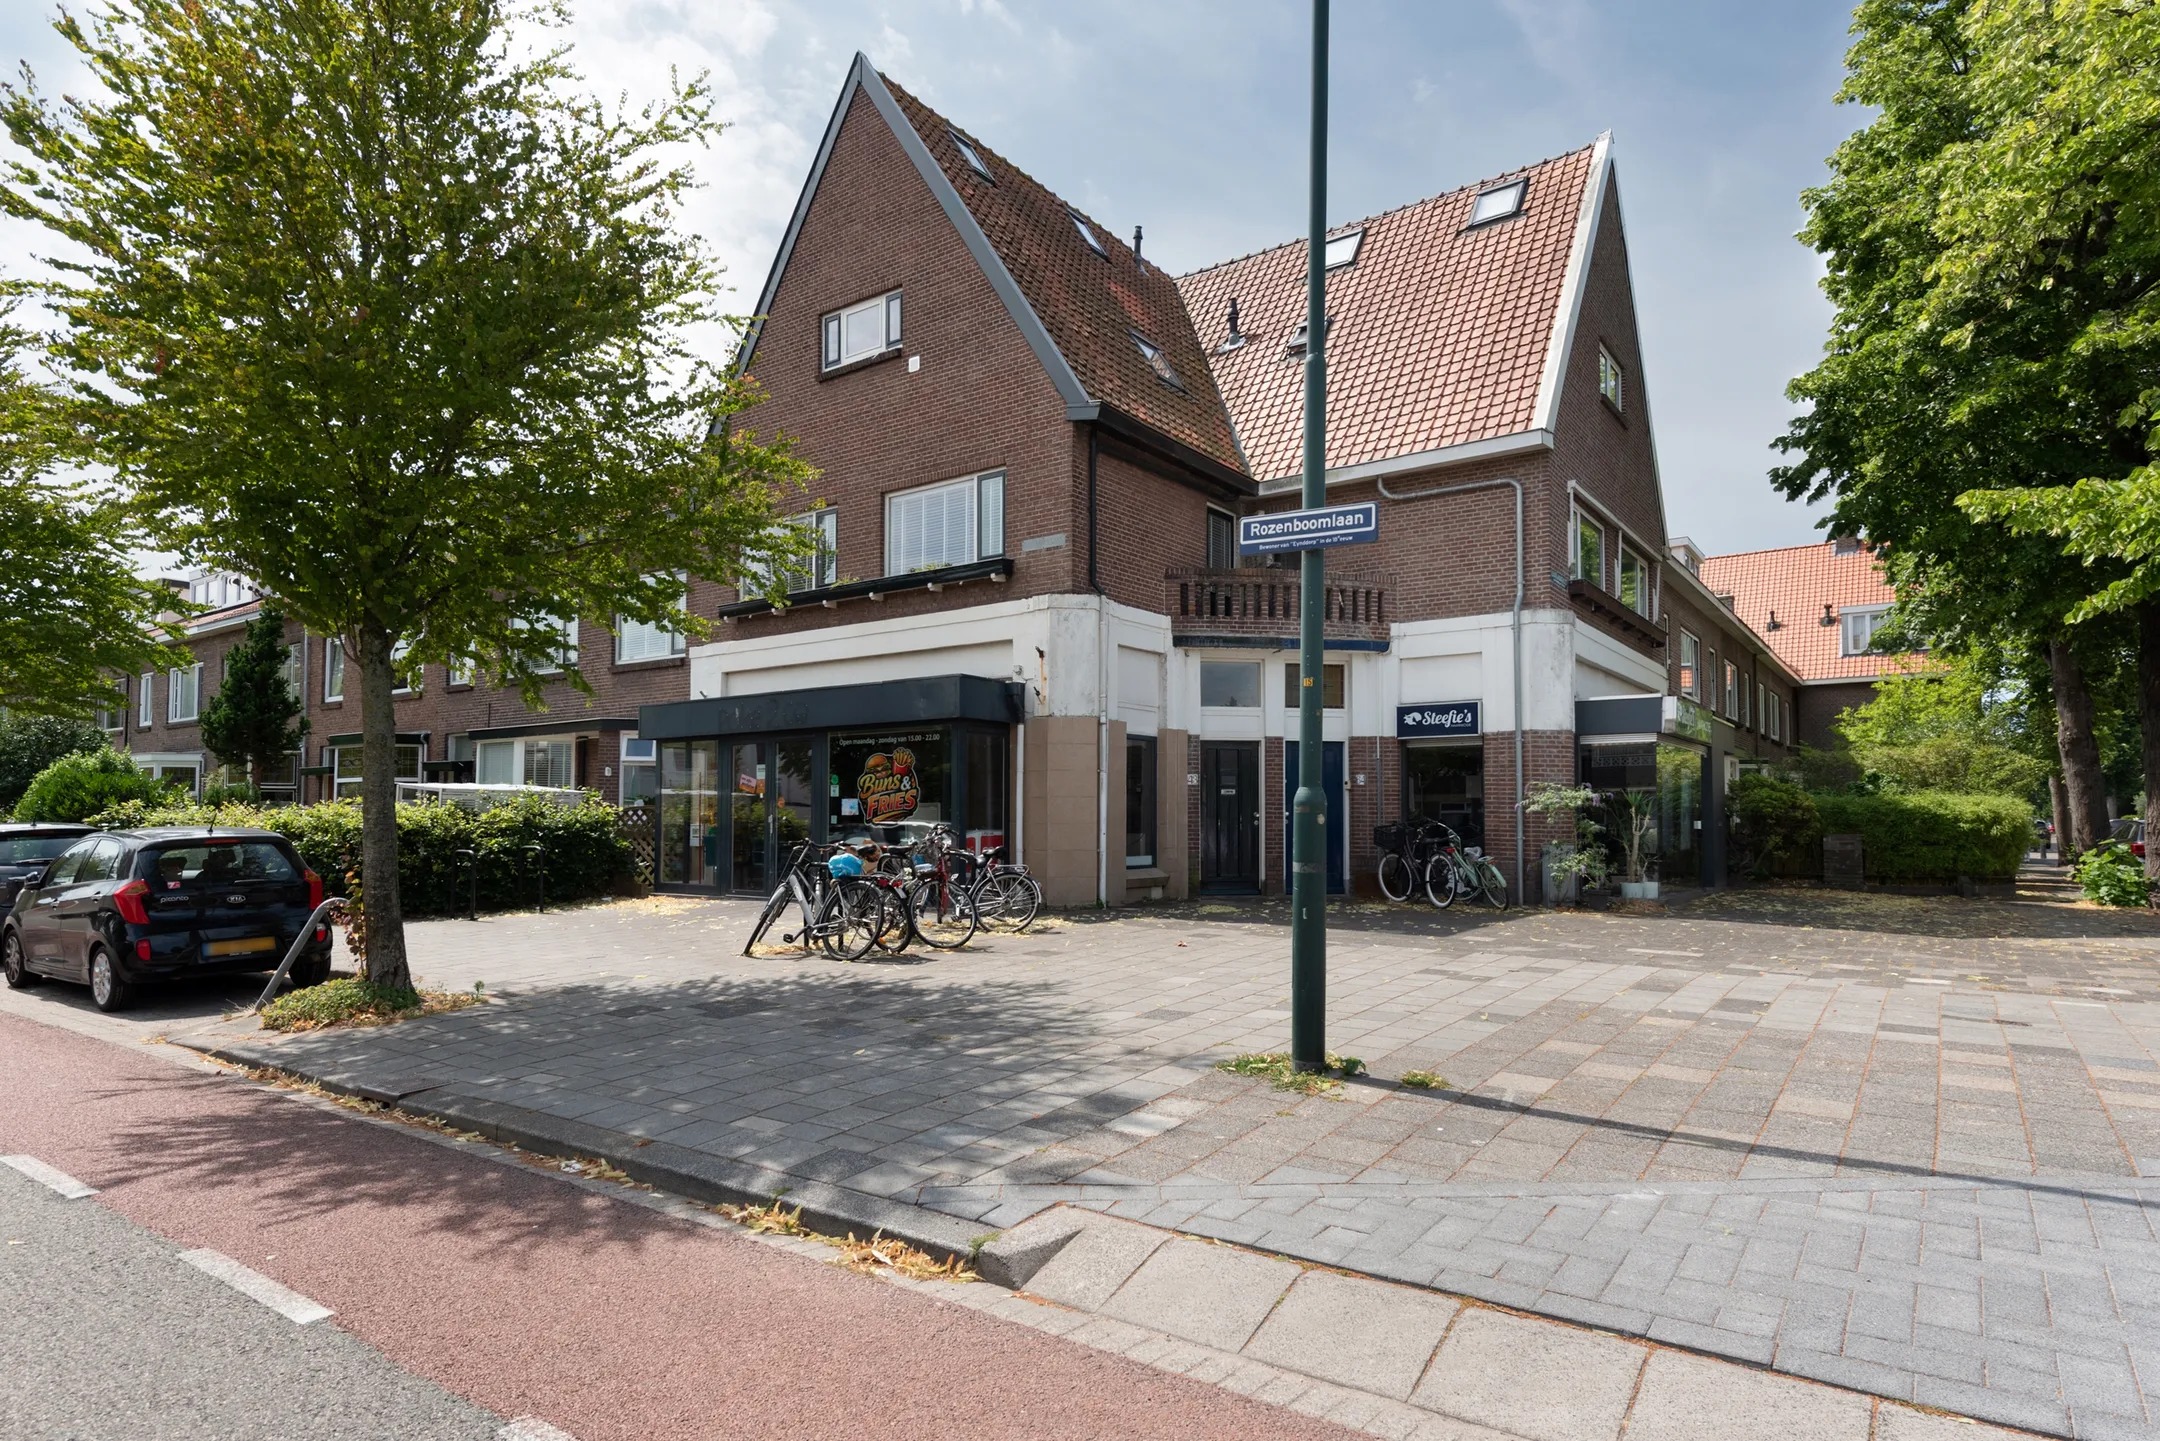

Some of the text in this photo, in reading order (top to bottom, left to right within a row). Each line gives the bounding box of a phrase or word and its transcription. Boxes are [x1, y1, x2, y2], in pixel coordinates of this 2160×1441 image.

[1250, 513, 1364, 537] Rozenboomlaan
[1422, 709, 1472, 728] Steefie's
[839, 738, 852, 747] Open
[853, 737, 875, 746] maandag
[878, 736, 897, 744] zondag
[907, 734, 922, 742] 15.00
[925, 733, 940, 741] 22.00
[860, 774, 901, 799] Buns
[901, 776, 912, 791] &
[867, 789, 917, 820] FRIES
[160, 895, 189, 904] picanto
